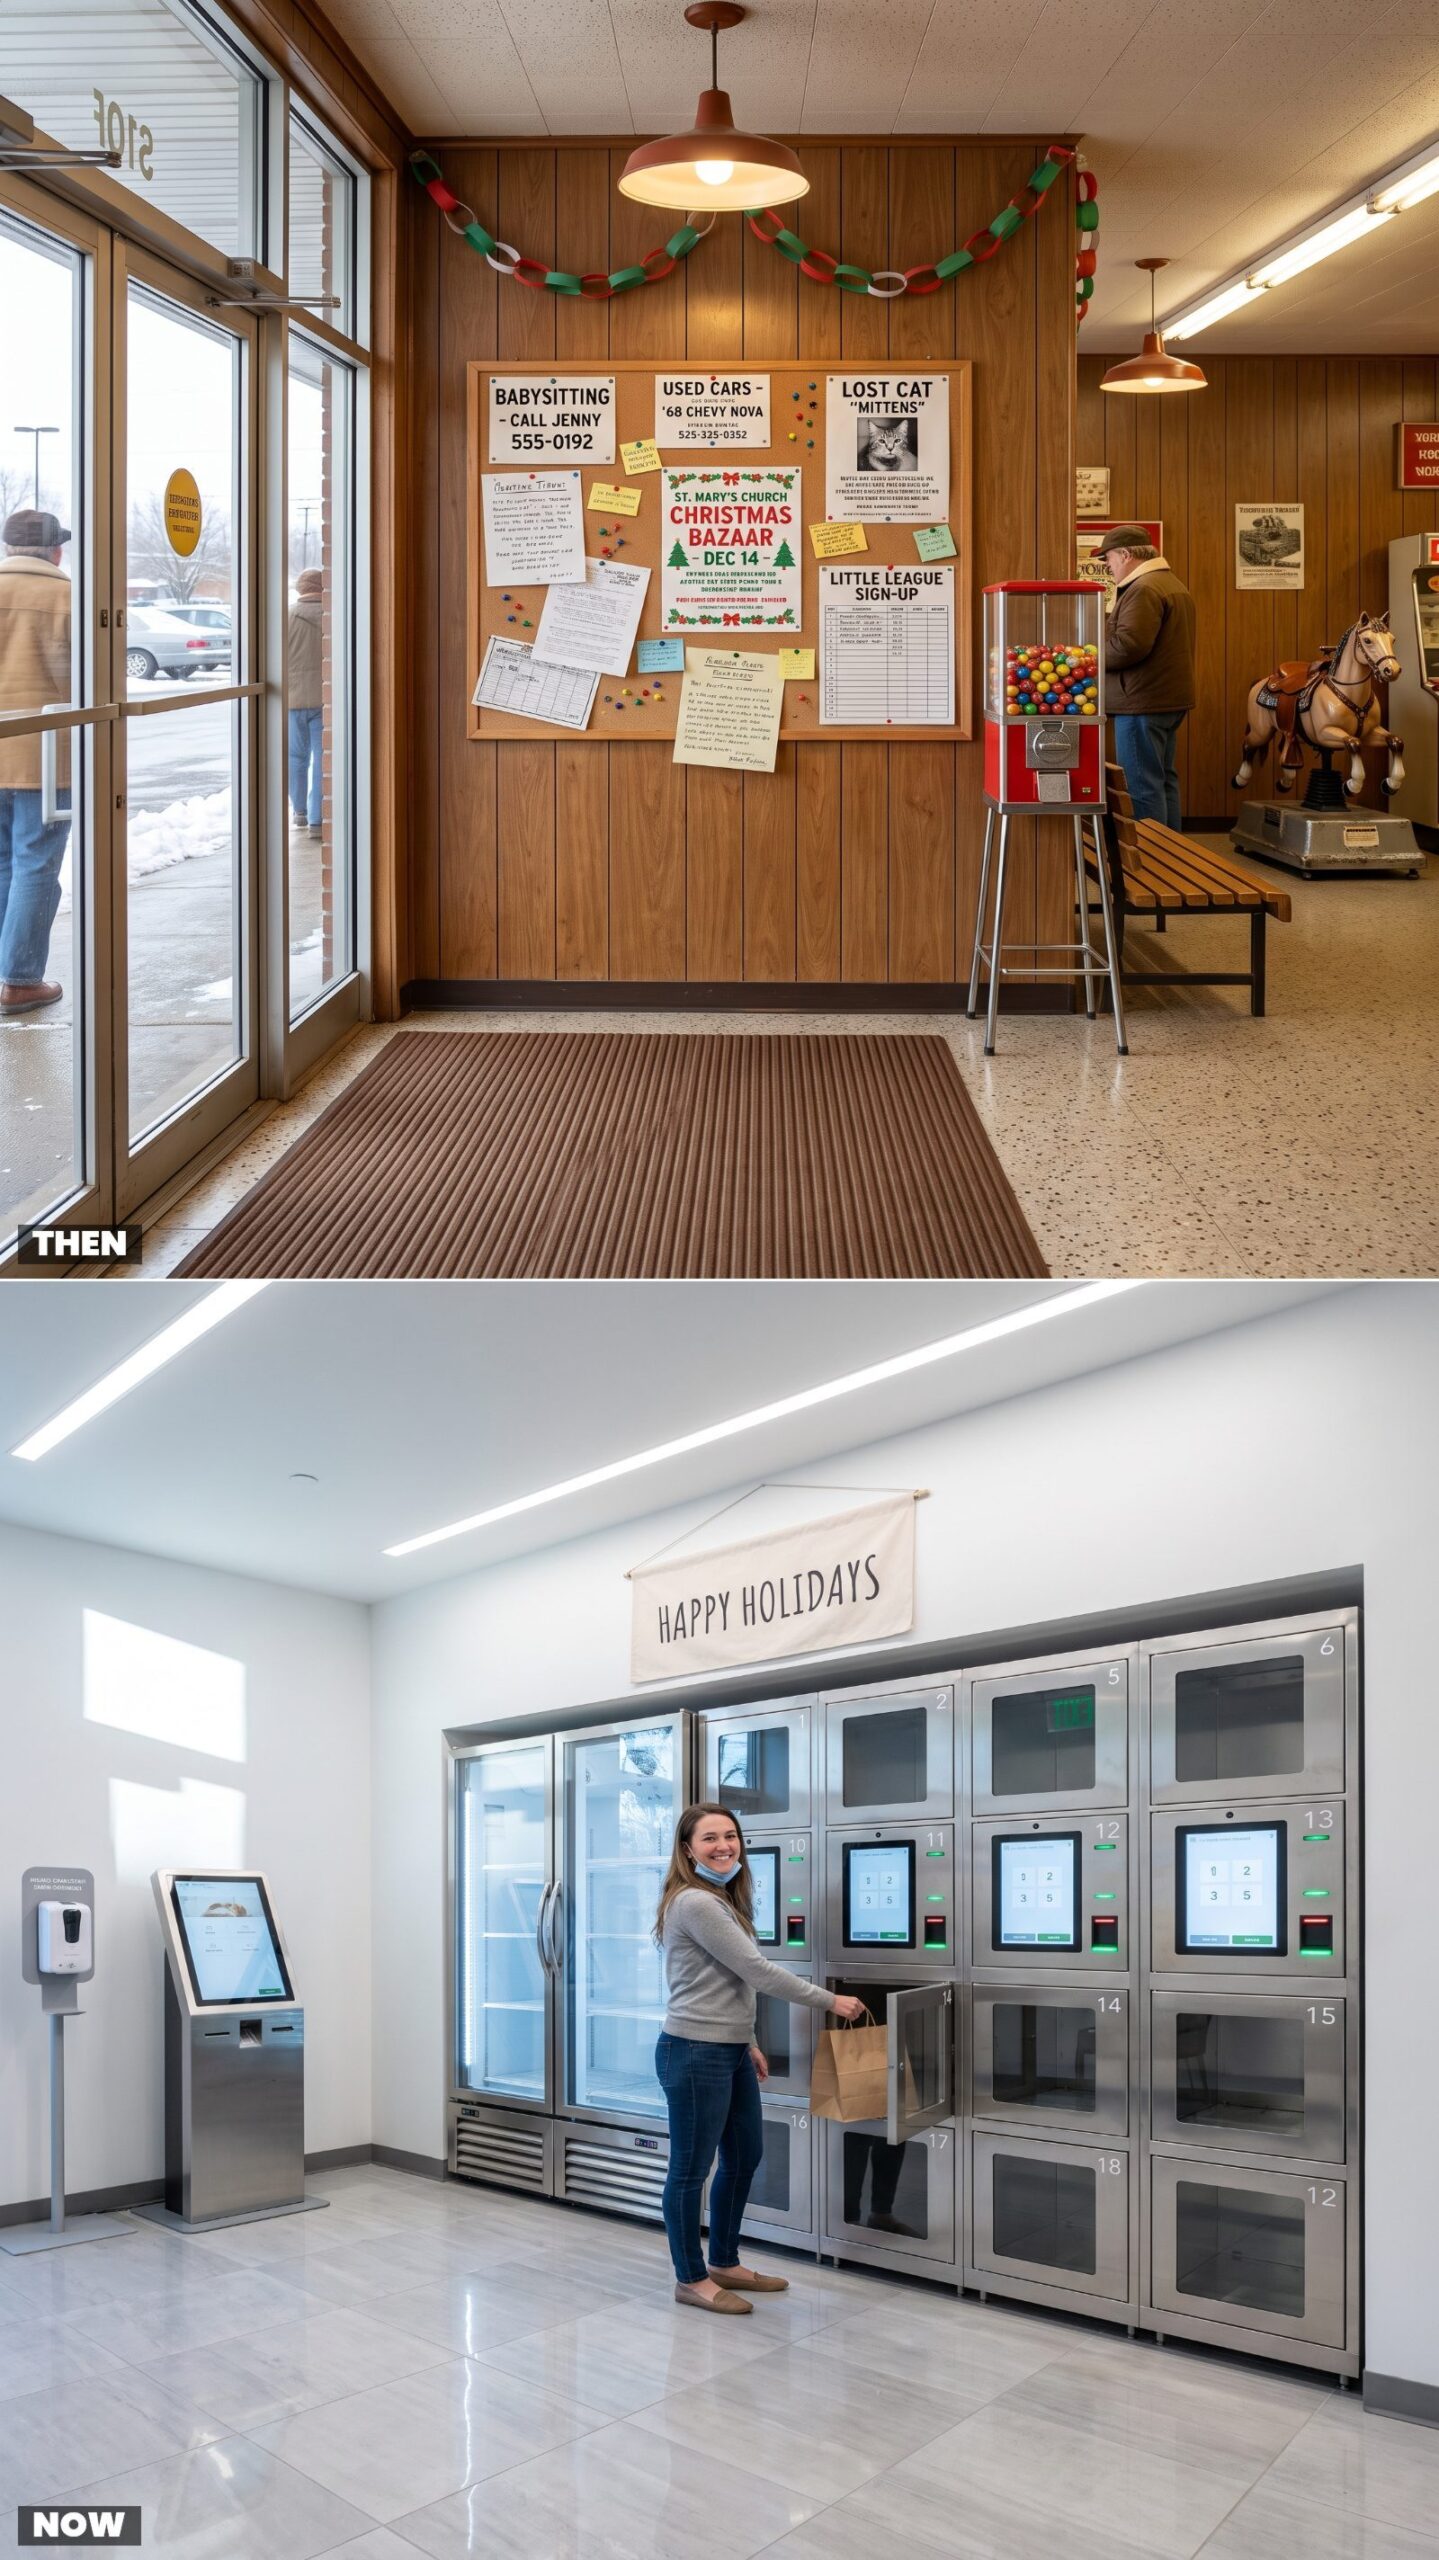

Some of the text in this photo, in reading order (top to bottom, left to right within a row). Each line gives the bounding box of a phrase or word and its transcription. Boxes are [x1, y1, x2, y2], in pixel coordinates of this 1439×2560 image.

[663, 381, 705, 396] USED
[710, 381, 752, 396] CARS
[842, 381, 933, 398] LOST CAT
[495, 388, 610, 405] BABYSITTING
[662, 406, 763, 417] '68 CHEVY NOVA
[850, 401, 925, 414] "MITTENS"
[510, 413, 547, 427] CALL
[552, 413, 602, 427] JENNY
[511, 433, 593, 450] 555-0192
[674, 492, 788, 503] ST. MARY'S CHURCH
[670, 505, 792, 525] CHRISTMAS
[688, 528, 774, 547] BAZAAR
[704, 551, 736, 566] DEC
[741, 551, 760, 566] 14
[830, 572, 944, 585] LITTLE LEAGUE
[855, 587, 919, 601] SIGN-UP
[658, 1554, 881, 1644] HAPPY HOLIDAYS
[1320, 1637, 1335, 1655] 6
[1108, 1667, 1120, 1685] 5
[936, 1693, 947, 1710] 2
[1304, 1809, 1334, 1829] 13
[1095, 1822, 1120, 1839] 12
[789, 1838, 806, 1853] 10
[927, 1832, 944, 1847] 11
[1047, 1872, 1053, 1880] 2
[1243, 1866, 1251, 1876] 2
[887, 1876, 893, 1884] 2
[866, 1896, 893, 1904] 3 5
[1020, 1894, 1053, 1903] 3 5
[1210, 1890, 1251, 1901] 3 5
[1098, 1997, 1121, 2013] 14
[1307, 2007, 1336, 2025] 15
[791, 2115, 808, 2129] 16
[930, 2134, 948, 2149] 17
[1098, 2158, 1121, 2175] 18
[1307, 2187, 1337, 2207] 12
